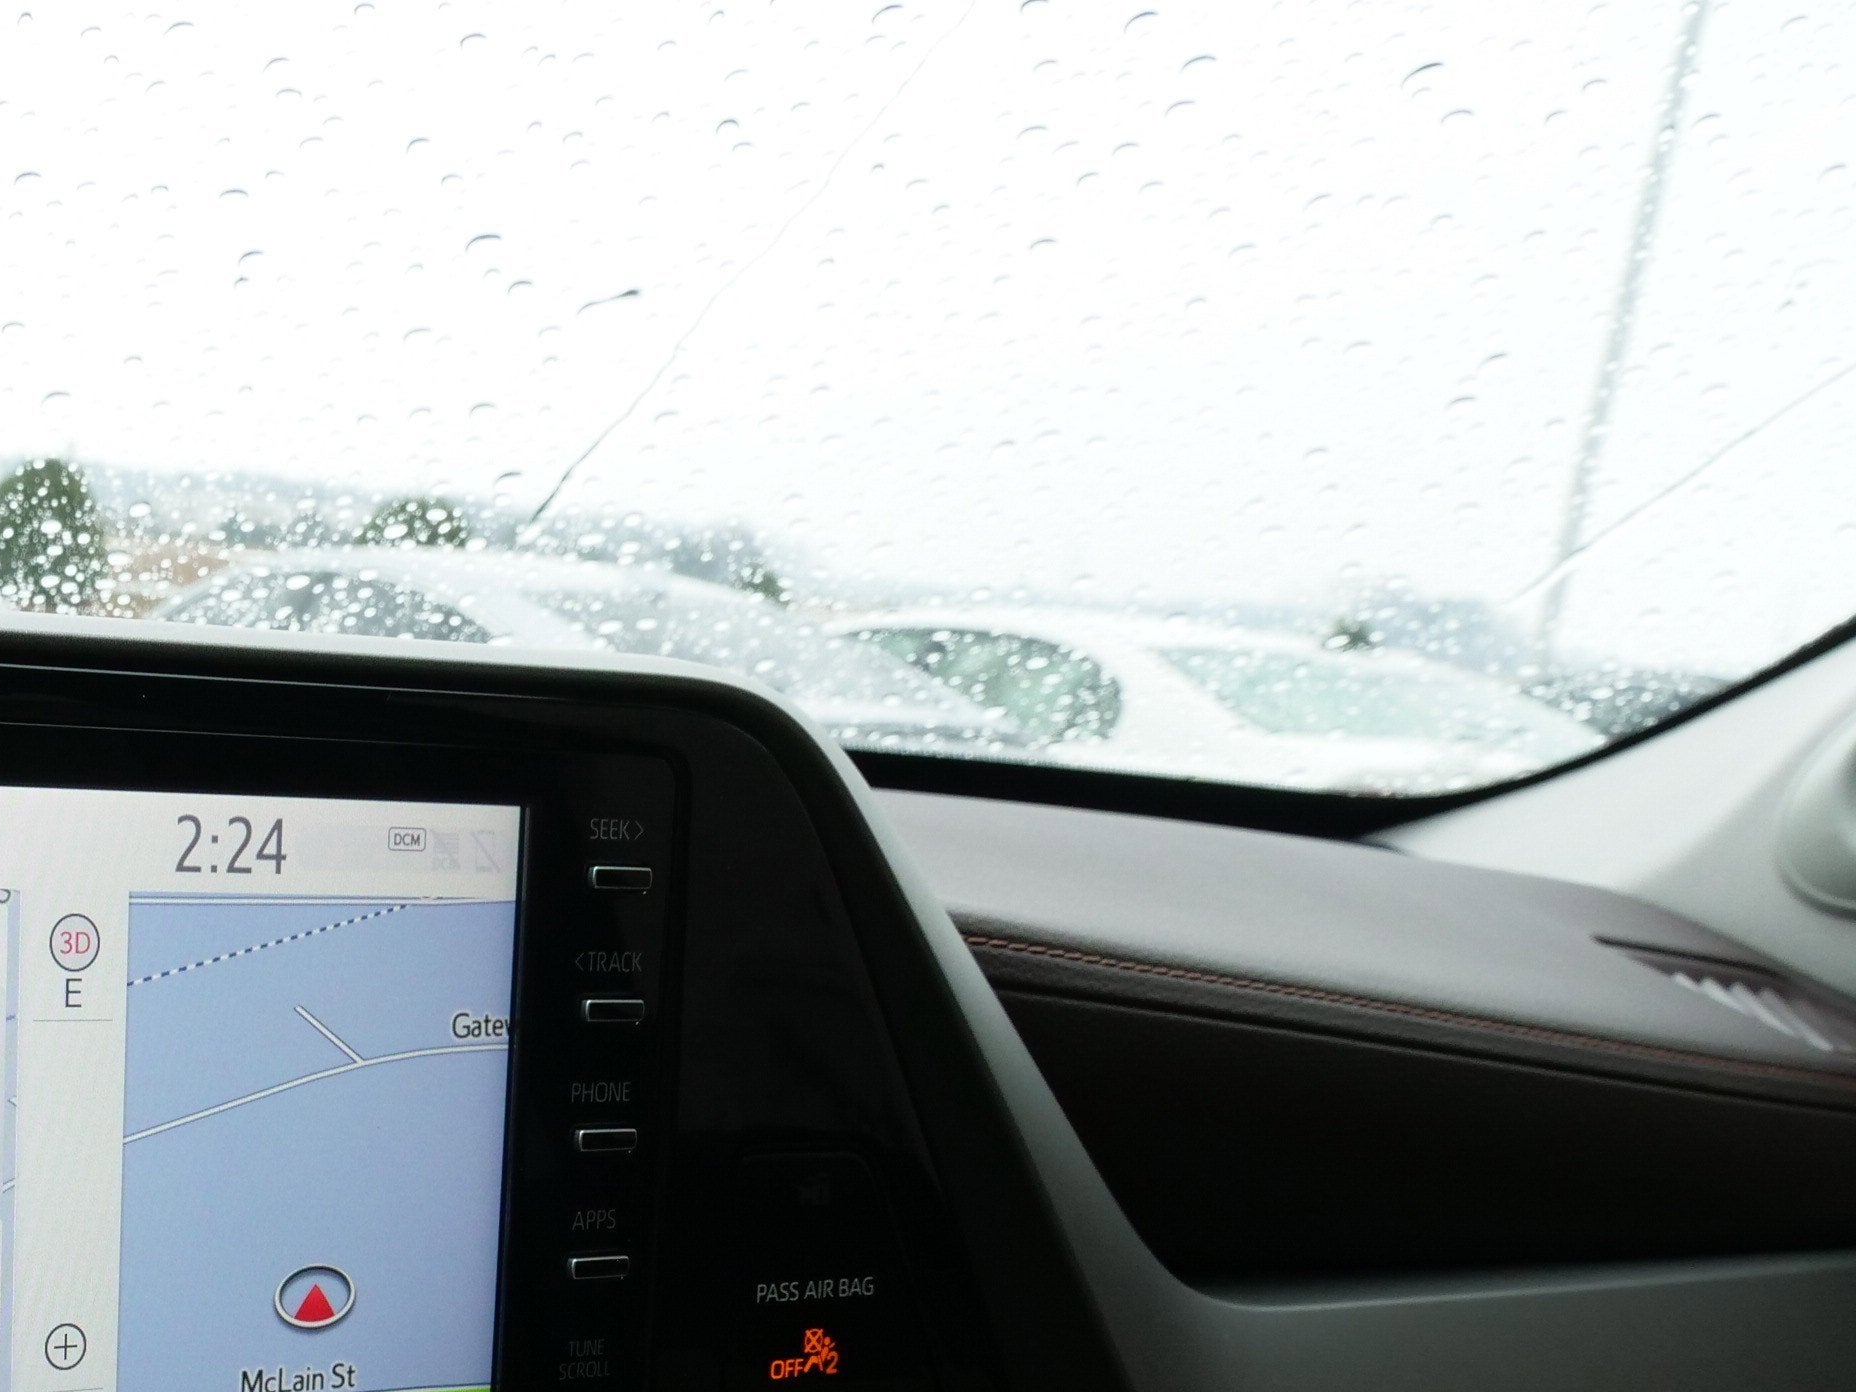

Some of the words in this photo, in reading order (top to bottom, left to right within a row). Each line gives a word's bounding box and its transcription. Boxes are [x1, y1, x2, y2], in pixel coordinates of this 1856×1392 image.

[174, 813, 287, 877] 2:24
[393, 832, 421, 847] DCM
[59, 930, 91, 955] 3D
[64, 978, 83, 1009] E
[571, 1082, 631, 1104] PHONE
[572, 1209, 617, 1232] APPS
[756, 1281, 800, 1304] PASS
[803, 1279, 835, 1300] AIR
[838, 1276, 875, 1298] BAG
[568, 1339, 606, 1359] TUNE
[330, 1362, 357, 1391] St
[559, 1359, 611, 1382] SCROLL
[770, 1358, 804, 1380] OFF
